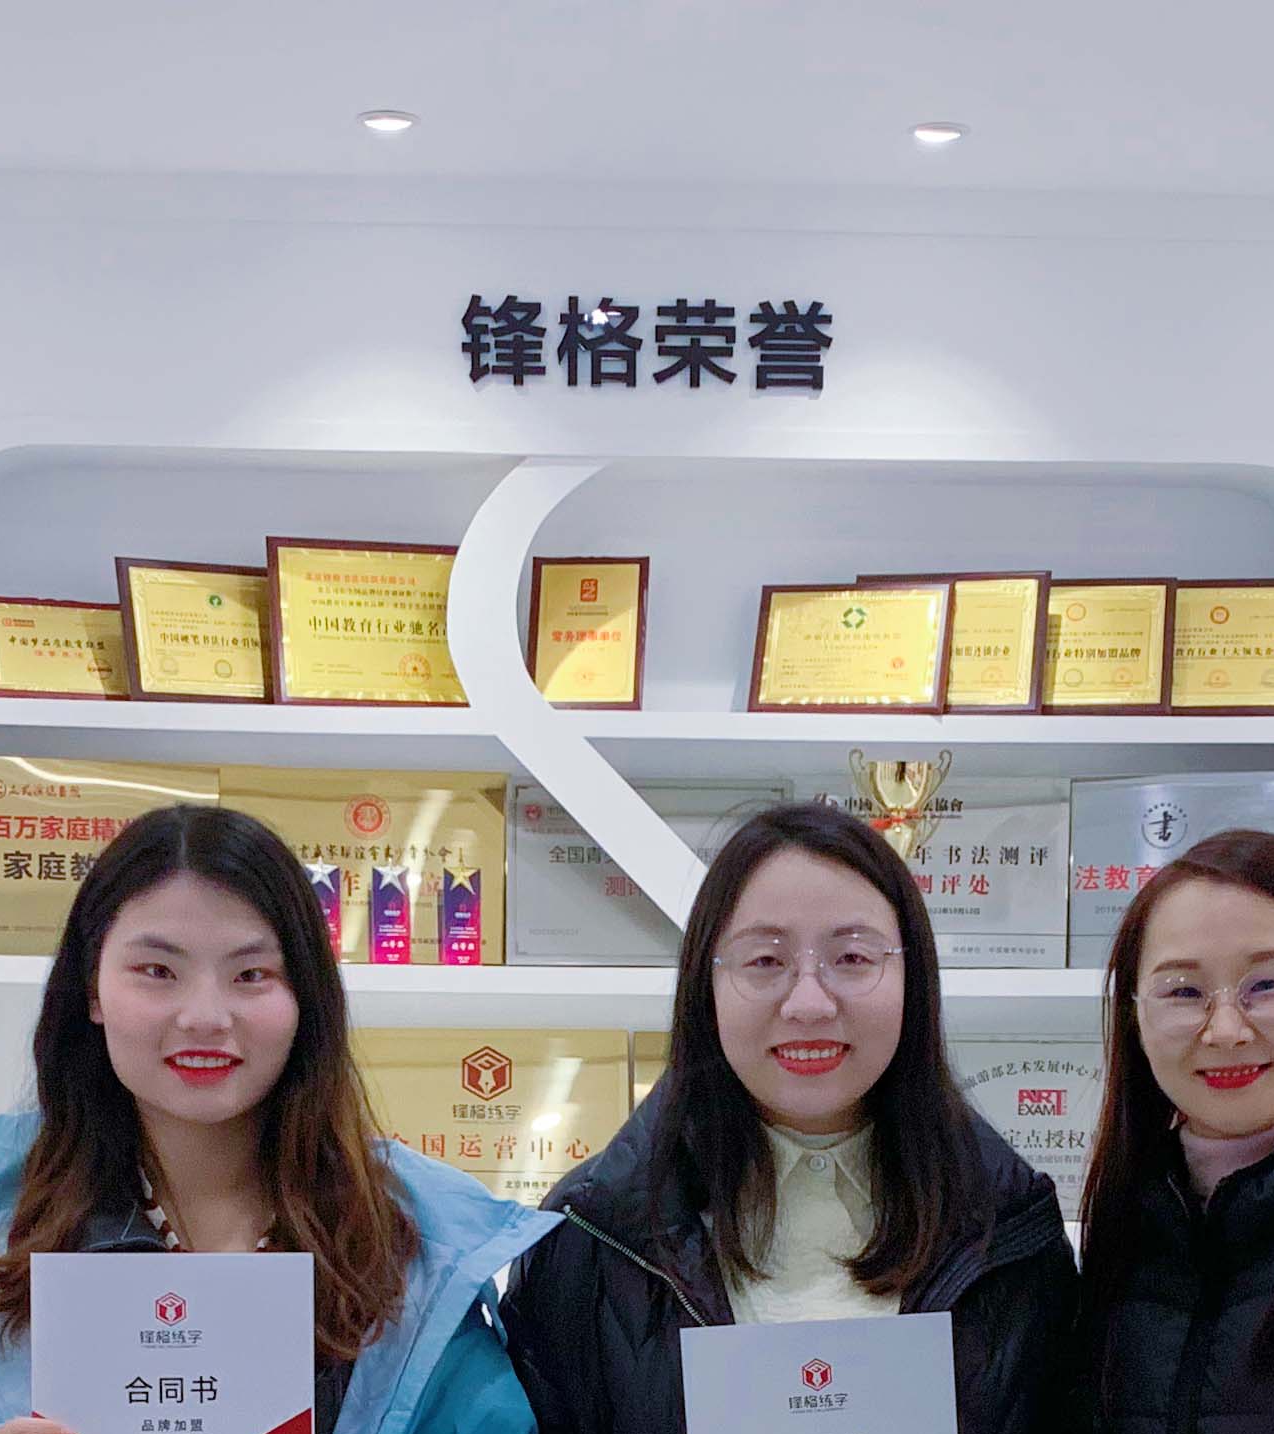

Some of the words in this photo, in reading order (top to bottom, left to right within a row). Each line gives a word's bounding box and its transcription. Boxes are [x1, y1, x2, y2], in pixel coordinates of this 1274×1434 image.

[461, 294, 834, 390] 锋格荣誉
[308, 615, 447, 637] 中国教育行业驰名
[453, 1103, 523, 1122] 锋格练字
[1017, 1104, 1056, 1116] EXAM
[139, 1329, 203, 1345] 锋格练字
[124, 1375, 219, 1405] 合同书
[788, 1392, 849, 1411] 锋格练字
[141, 1418, 204, 1433] 品牌加盟
